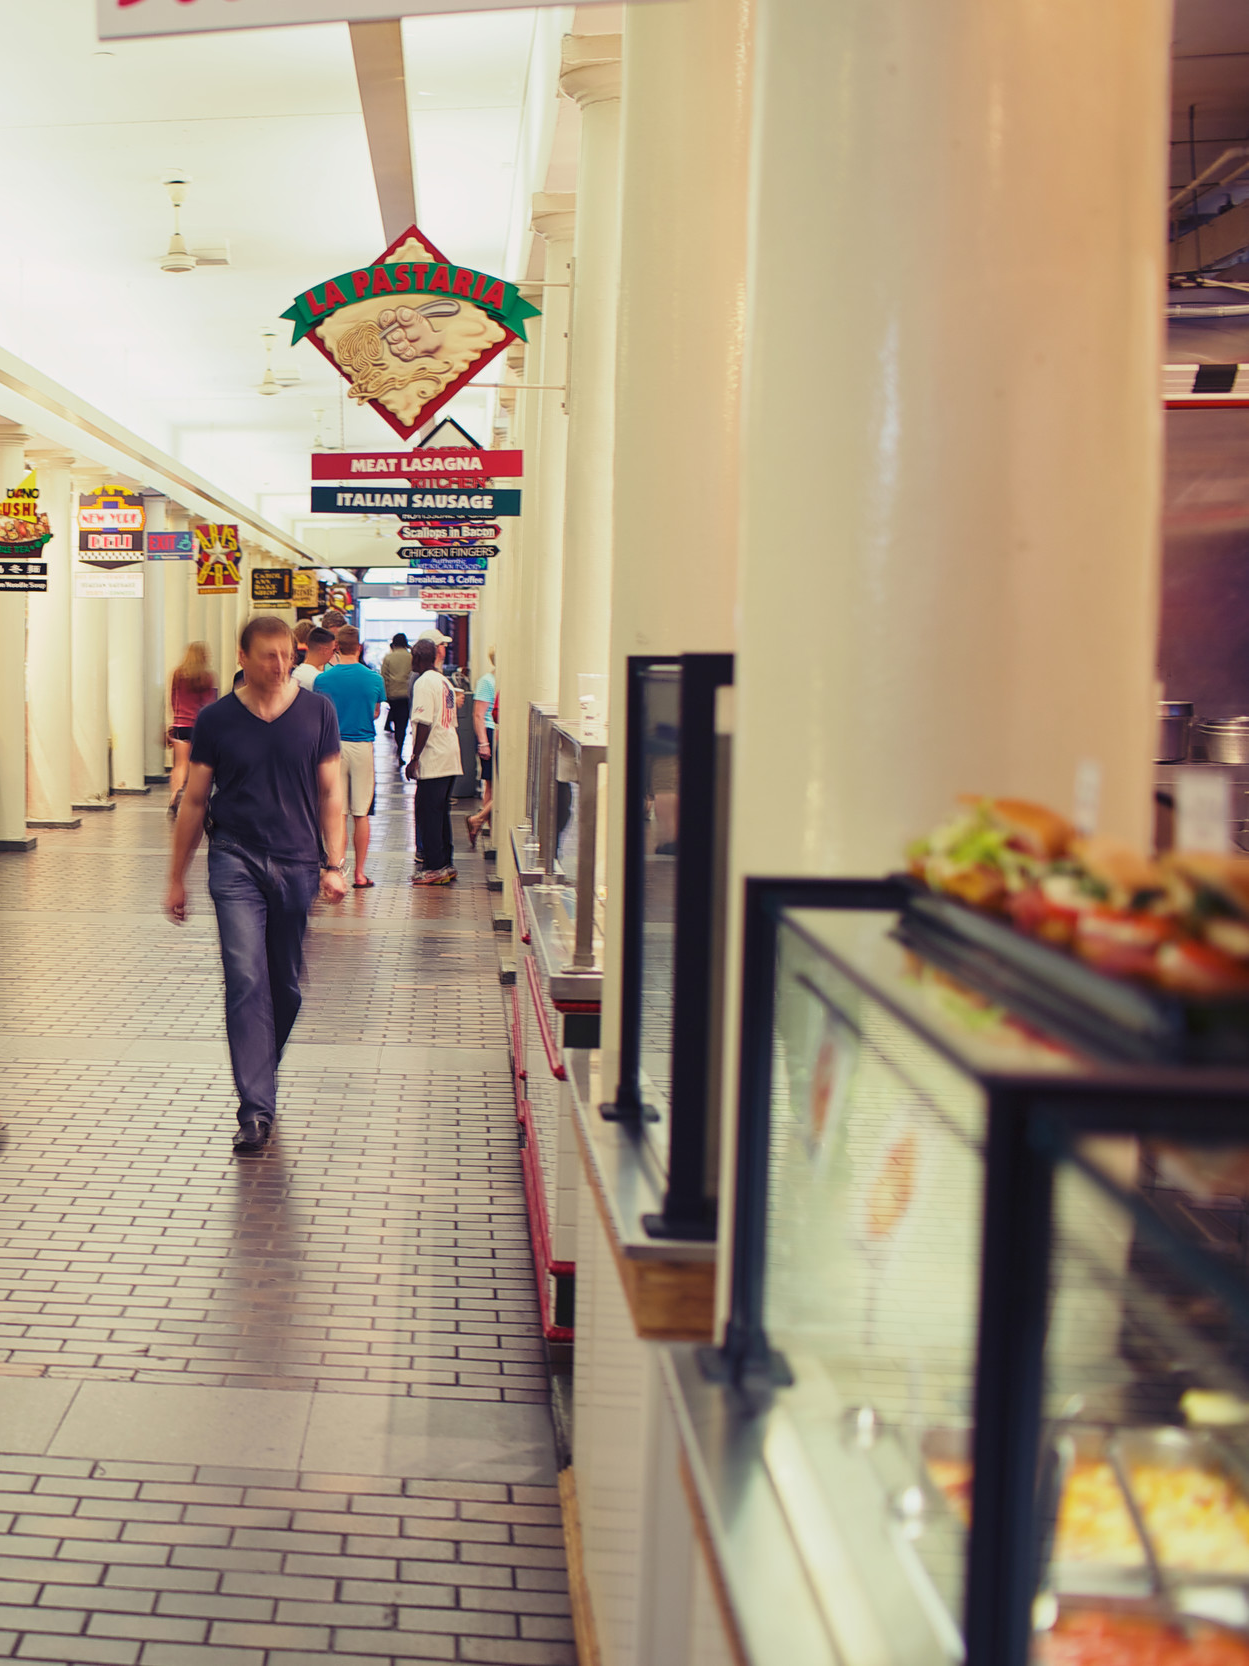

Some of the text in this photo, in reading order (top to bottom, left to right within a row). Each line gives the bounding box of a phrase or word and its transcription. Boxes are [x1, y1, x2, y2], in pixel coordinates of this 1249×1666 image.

[304, 263, 506, 317] LA PASTARIA
[350, 456, 483, 473] MEAT LASAGNA
[336, 492, 494, 510] ITALIAN SAUSAGE
[401, 525, 495, 539] Scallops in Bacon
[87, 534, 133, 549] DELI
[148, 534, 178, 551] EXIT
[401, 547, 495, 558] CHICKEN FINGERS
[407, 574, 485, 584] Breakfast & Coffee
[420, 590, 478, 599] Sandwiches
[421, 601, 477, 610] breakfast
